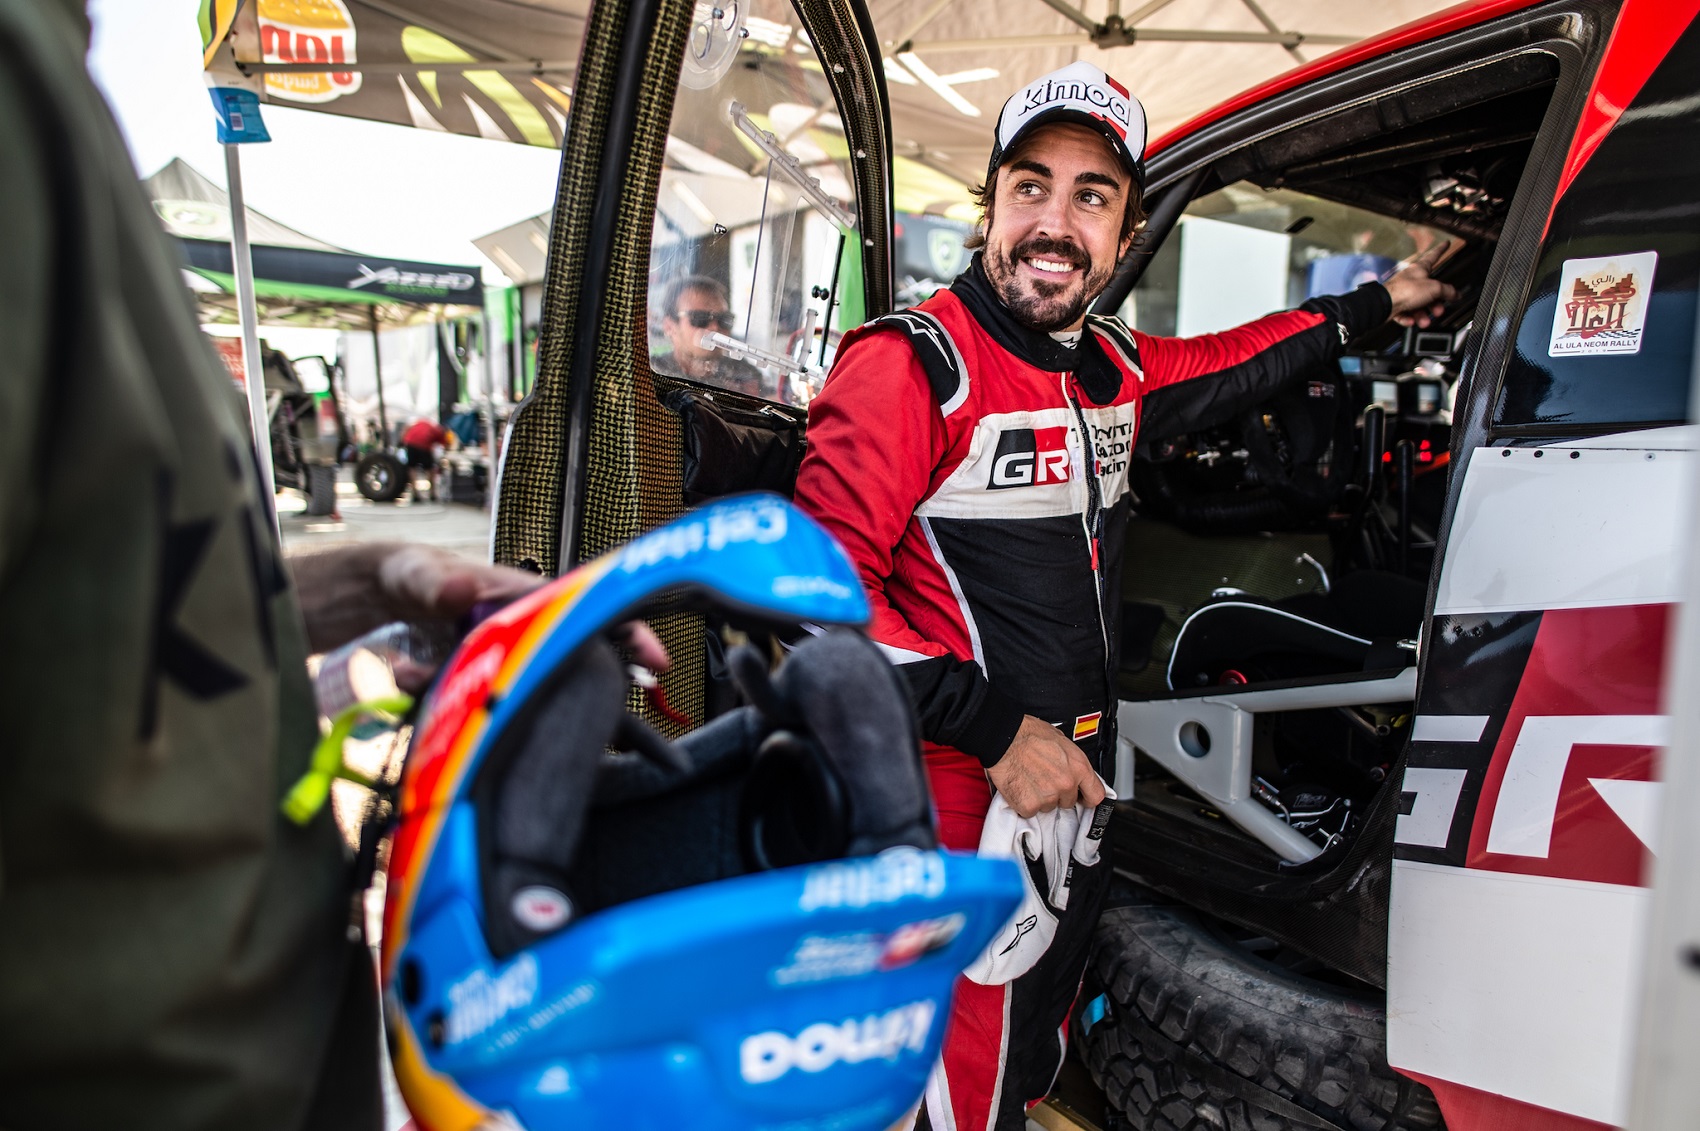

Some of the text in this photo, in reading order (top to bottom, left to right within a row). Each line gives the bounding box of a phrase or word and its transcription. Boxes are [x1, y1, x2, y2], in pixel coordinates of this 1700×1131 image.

[1018, 80, 1131, 126] kimoa
[1610, 339, 1638, 347] RALLY
[992, 449, 1069, 486] GR
